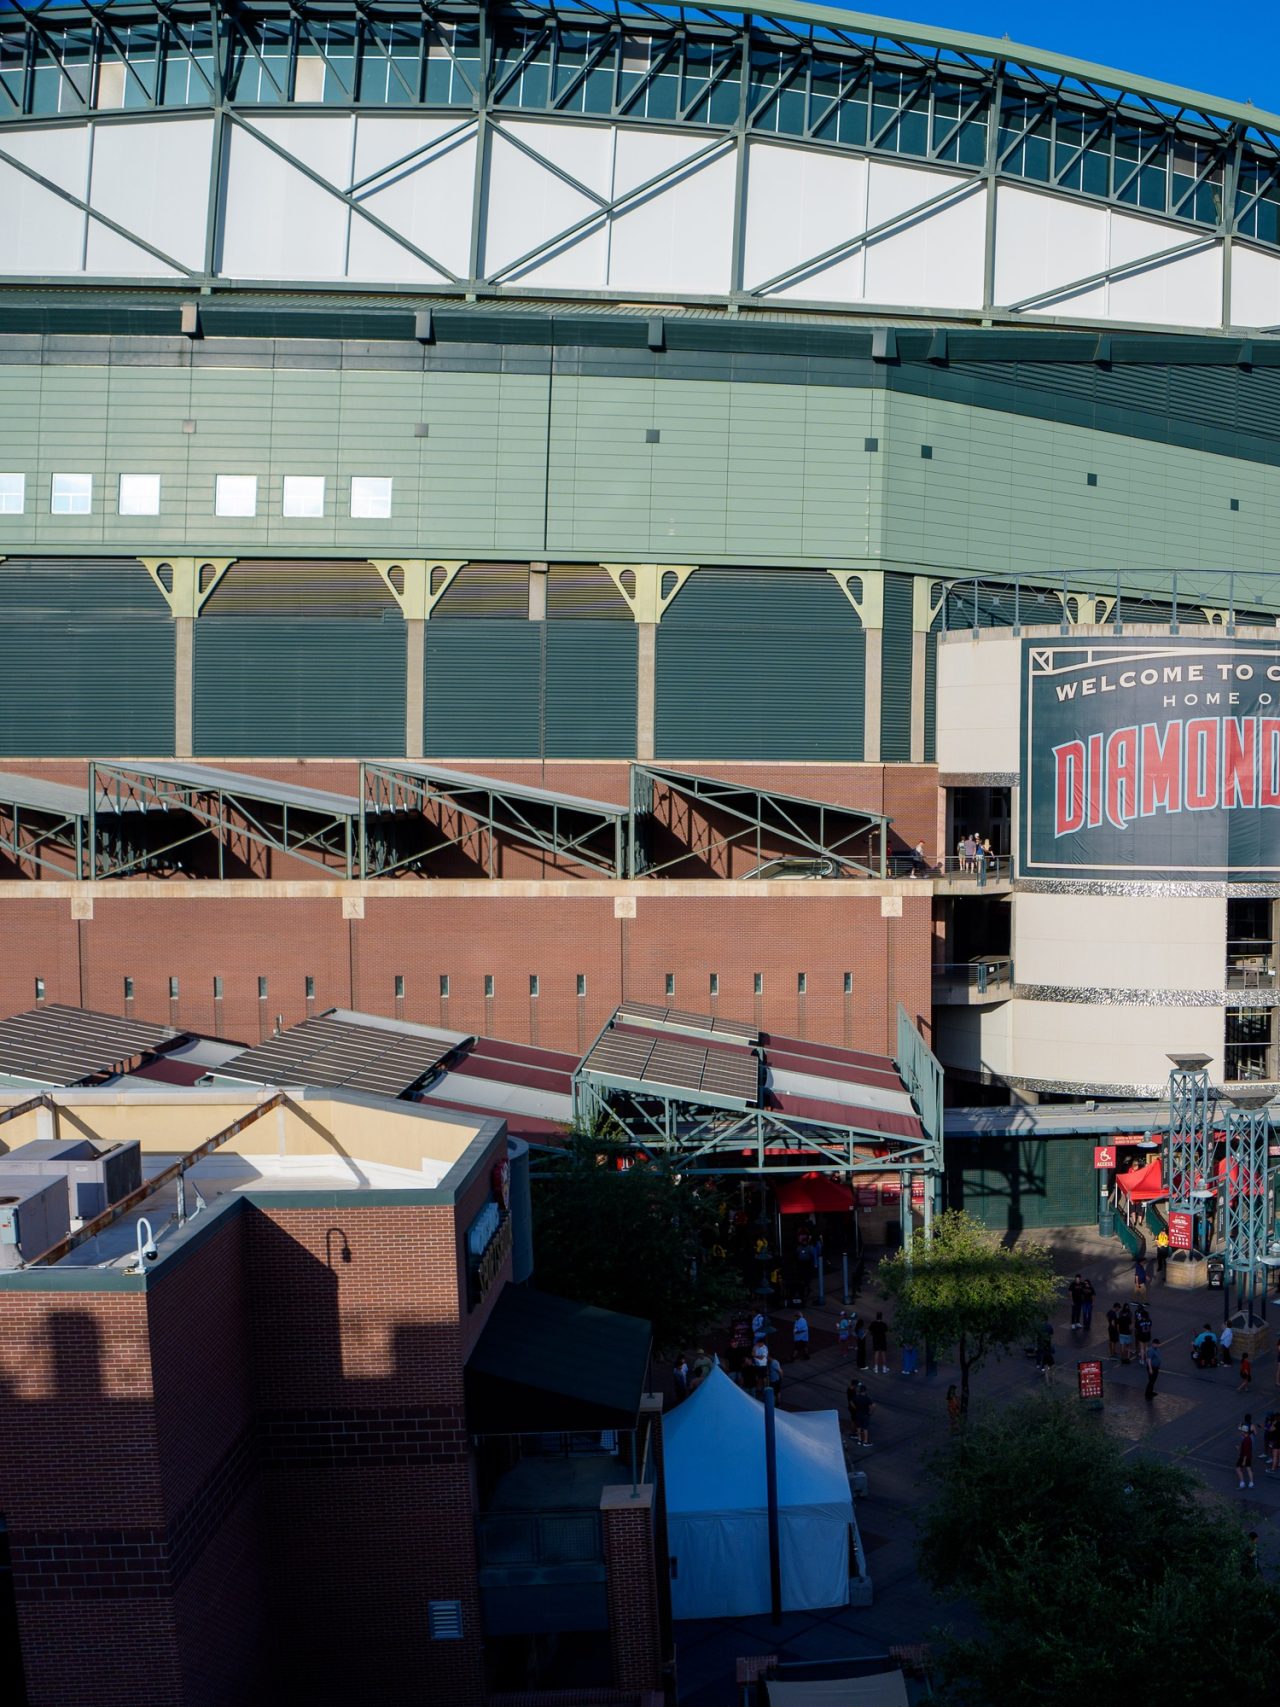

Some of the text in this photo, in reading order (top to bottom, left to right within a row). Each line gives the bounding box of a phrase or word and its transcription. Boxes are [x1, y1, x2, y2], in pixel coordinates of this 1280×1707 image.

[1056, 665, 1203, 701] WELCOME
[1217, 664, 1253, 680] TO
[1163, 692, 1240, 707] HOME
